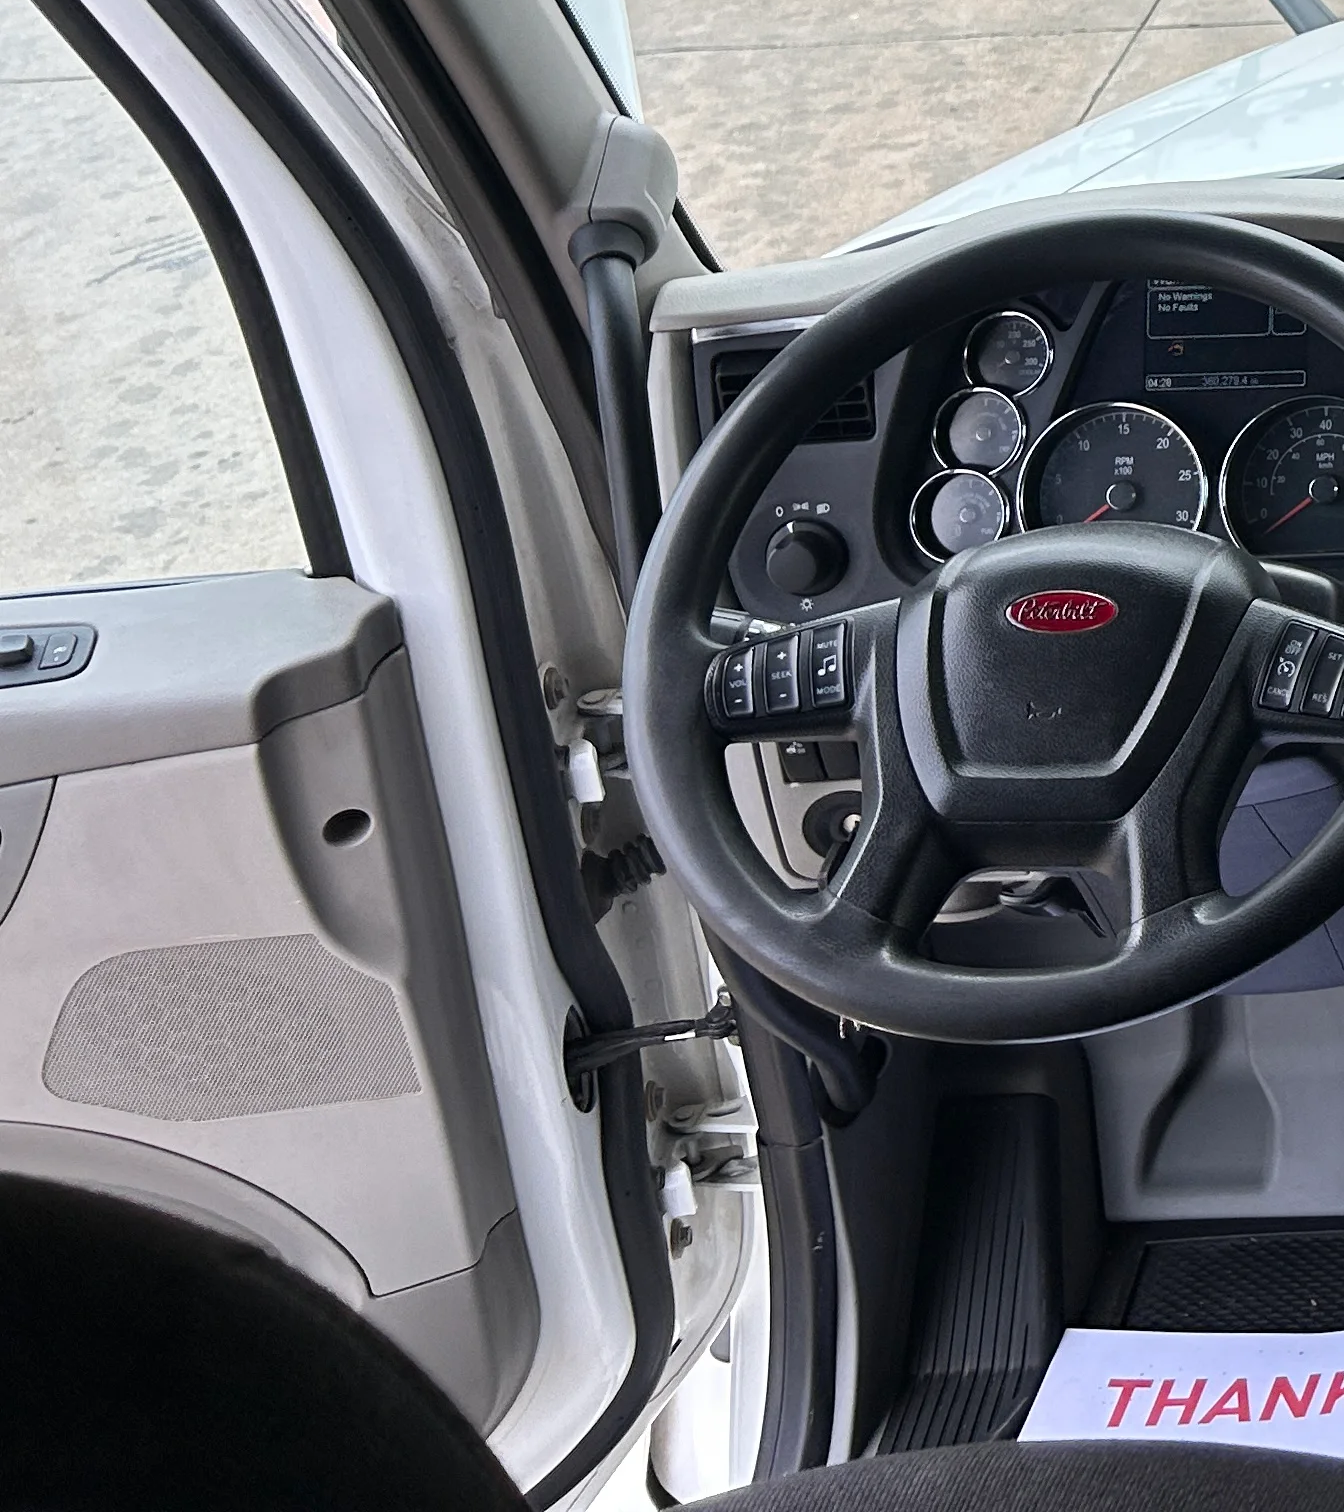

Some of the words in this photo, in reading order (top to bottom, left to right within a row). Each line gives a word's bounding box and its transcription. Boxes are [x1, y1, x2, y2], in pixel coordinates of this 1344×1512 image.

[1158, 292, 1171, 301] No
[1173, 292, 1213, 303] Warnings
[1158, 303, 1171, 312] No
[1172, 303, 1199, 312] Faults
[1117, 424, 1130, 435] 15
[1319, 419, 1333, 430] 40
[1290, 427, 1303, 439] 30
[1078, 440, 1090, 451] 10
[1156, 437, 1170, 449] 20
[1114, 456, 1134, 465] RPM
[1266, 449, 1280, 461] 20
[1291, 452, 1300, 460] 40
[1316, 452, 1334, 462] MPH
[1114, 466, 1133, 476] x100
[1178, 470, 1192, 481] 25
[1055, 473, 1062, 485] 5
[1256, 477, 1267, 488] 10
[1175, 510, 1189, 522] 30
[1260, 508, 1268, 519] 0
[1056, 514, 1063, 525] 0
[1017, 598, 1108, 622] Peterbilt
[816, 640, 838, 650] MUTE
[1290, 639, 1303, 649] ON
[1284, 645, 1303, 656] OFF
[1327, 651, 1343, 661] SET
[771, 670, 793, 681] SEEK
[728, 679, 747, 689] VOL
[816, 683, 841, 695] MODE
[1311, 692, 1328, 704] RES
